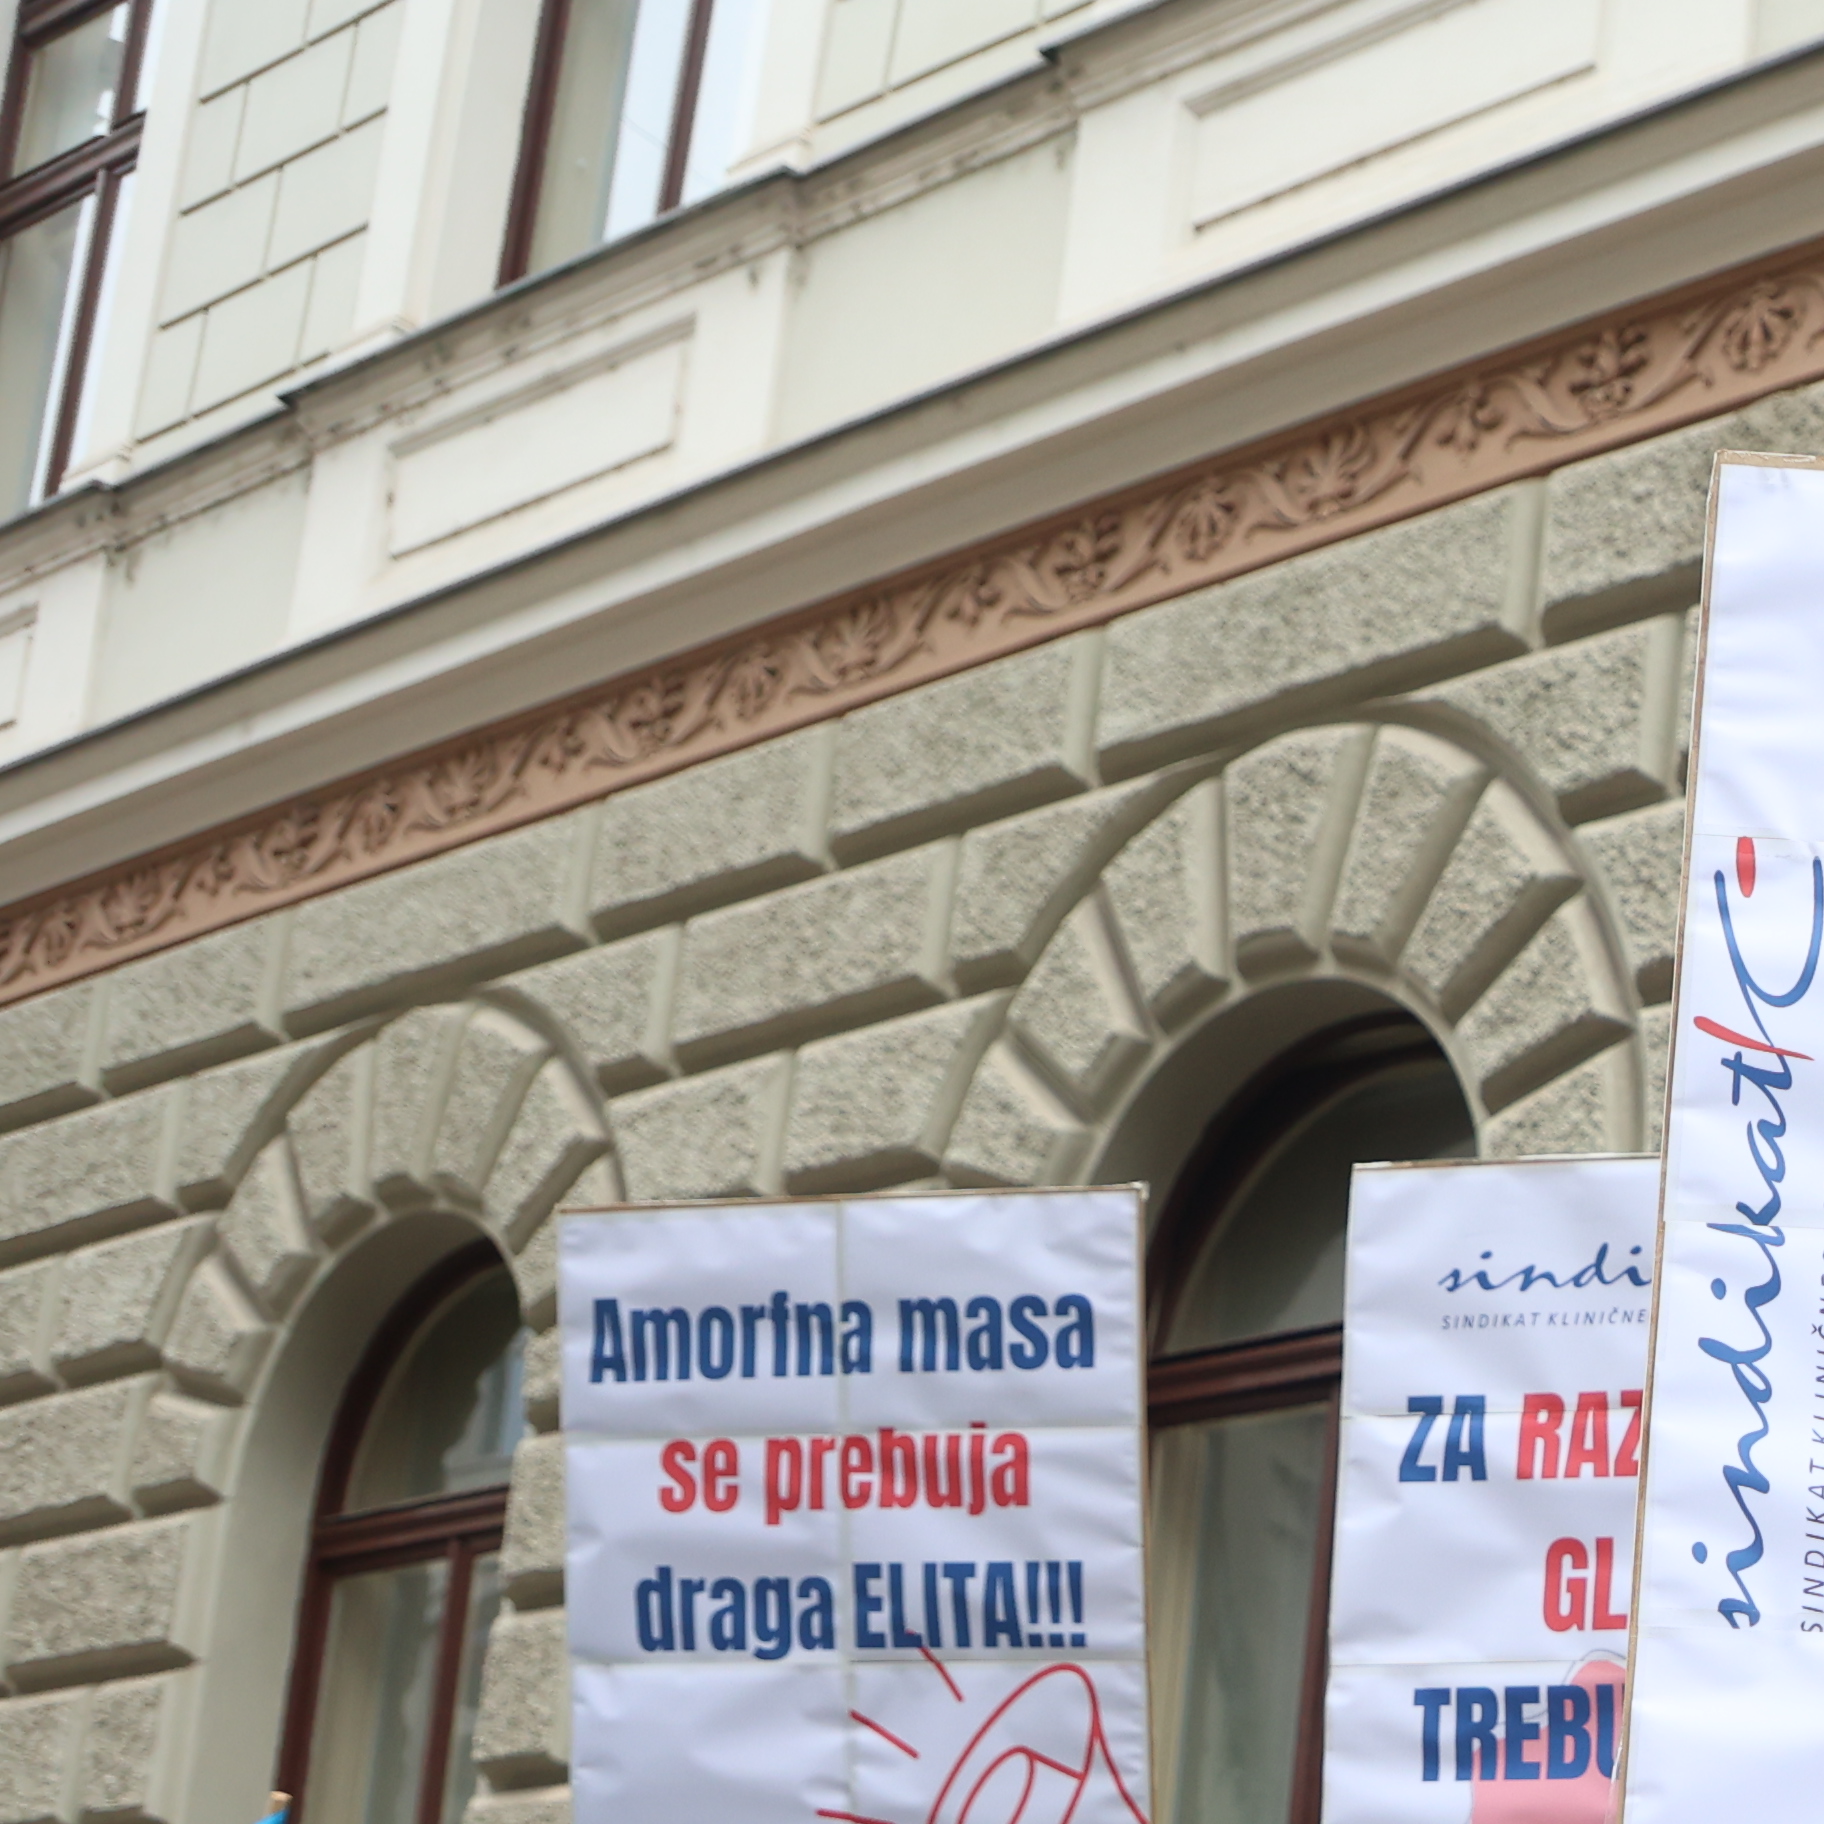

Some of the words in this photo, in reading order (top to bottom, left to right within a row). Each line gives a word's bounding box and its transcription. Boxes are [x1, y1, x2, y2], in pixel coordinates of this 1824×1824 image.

[589, 1291, 871, 1383] Amorfna
[898, 1292, 1096, 1372] masa
[1441, 1311, 1541, 1331] SINDIKAT
[1549, 1306, 1647, 1326] KLINIČNE
[658, 1435, 740, 1514] se
[764, 1421, 1031, 1525] prebuja
[1399, 1395, 1487, 1483] ZA
[1517, 1390, 1643, 1479] RAZ
[636, 1565, 835, 1661] draga
[855, 1560, 1086, 1649] ELITA!!!
[1543, 1536, 1628, 1632] GL
